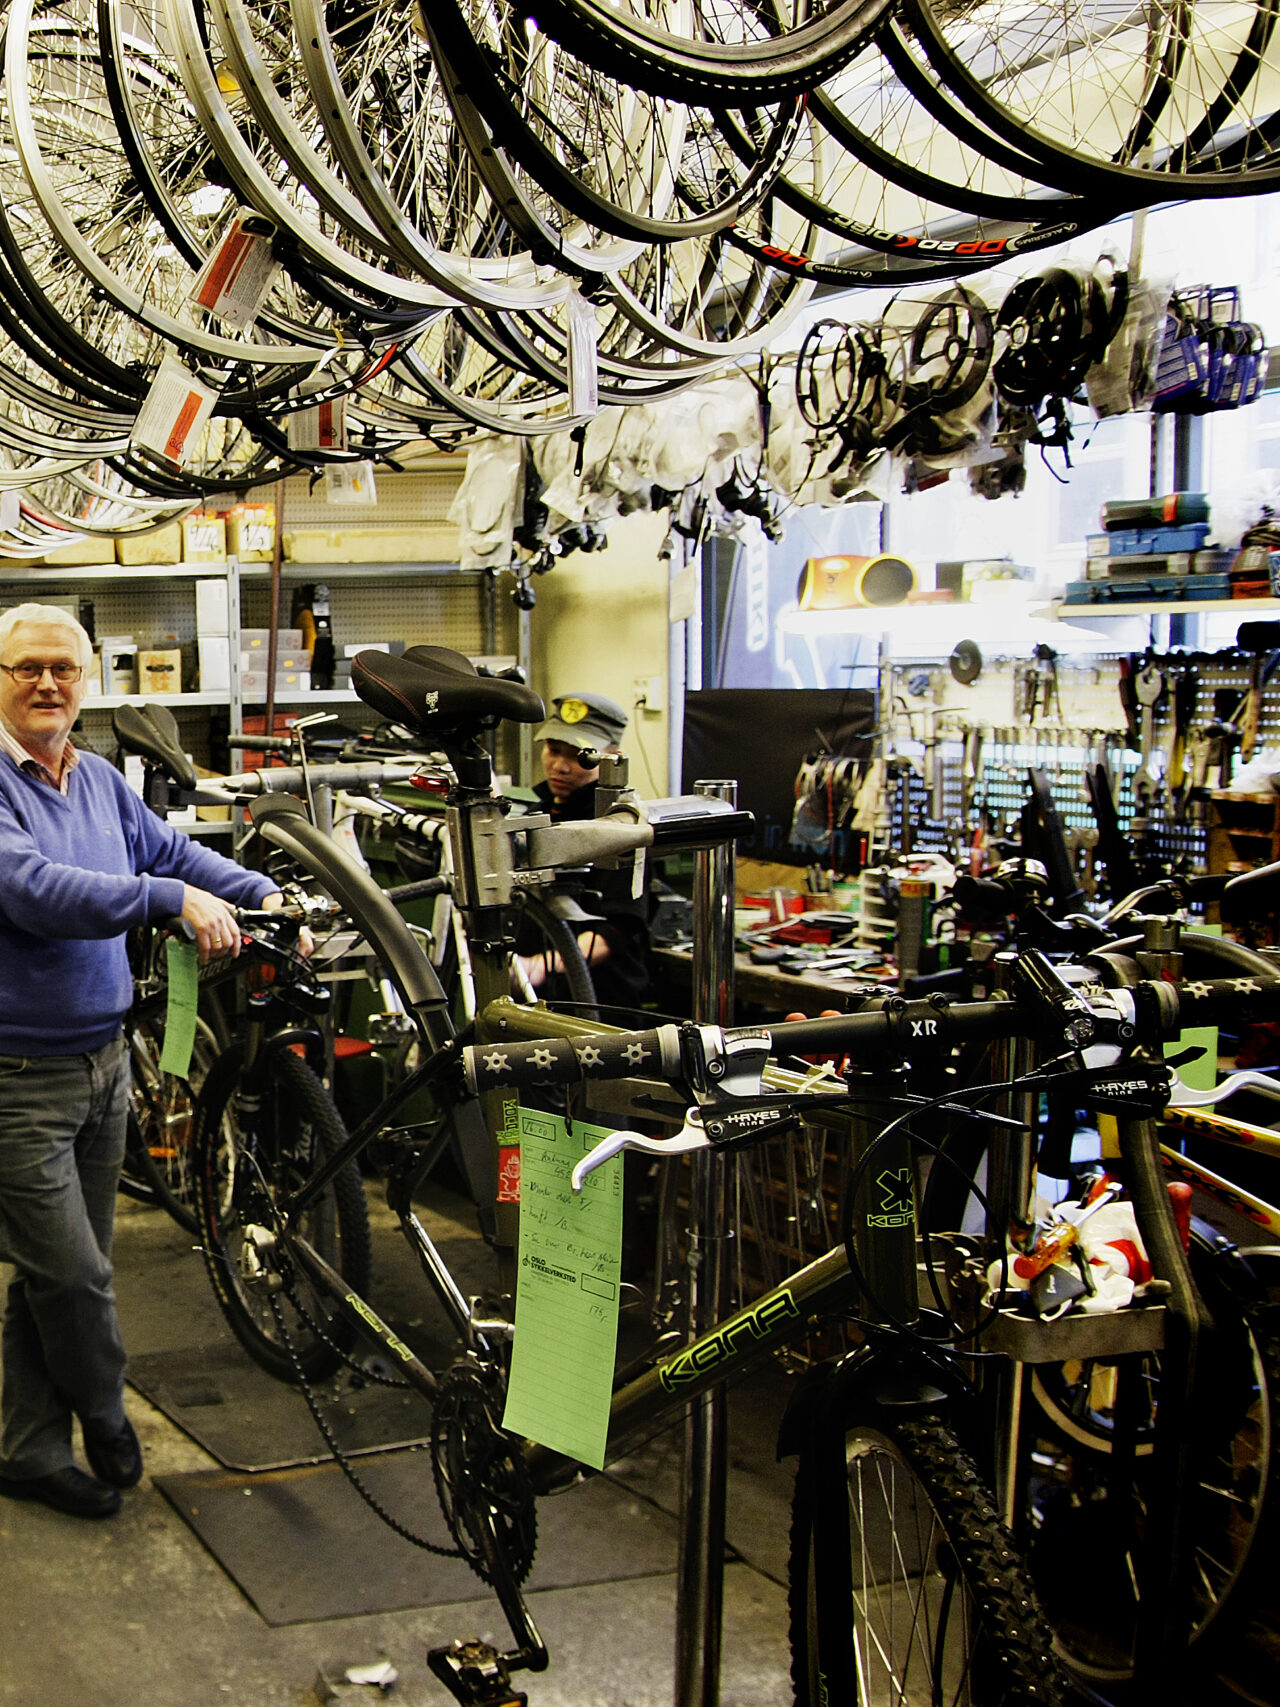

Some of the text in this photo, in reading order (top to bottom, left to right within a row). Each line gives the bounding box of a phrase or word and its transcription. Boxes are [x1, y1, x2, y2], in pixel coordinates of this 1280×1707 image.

[836, 214, 891, 241] DISC
[918, 238, 1008, 254] DP20
[910, 1019, 937, 1037] XR
[1091, 1080, 1148, 1093] HAYES
[723, 1110, 780, 1124] HAYES
[867, 1210, 915, 1228] KON
[531, 1255, 546, 1266] OSLO
[531, 1262, 577, 1284] SYKKELVERKSTED
